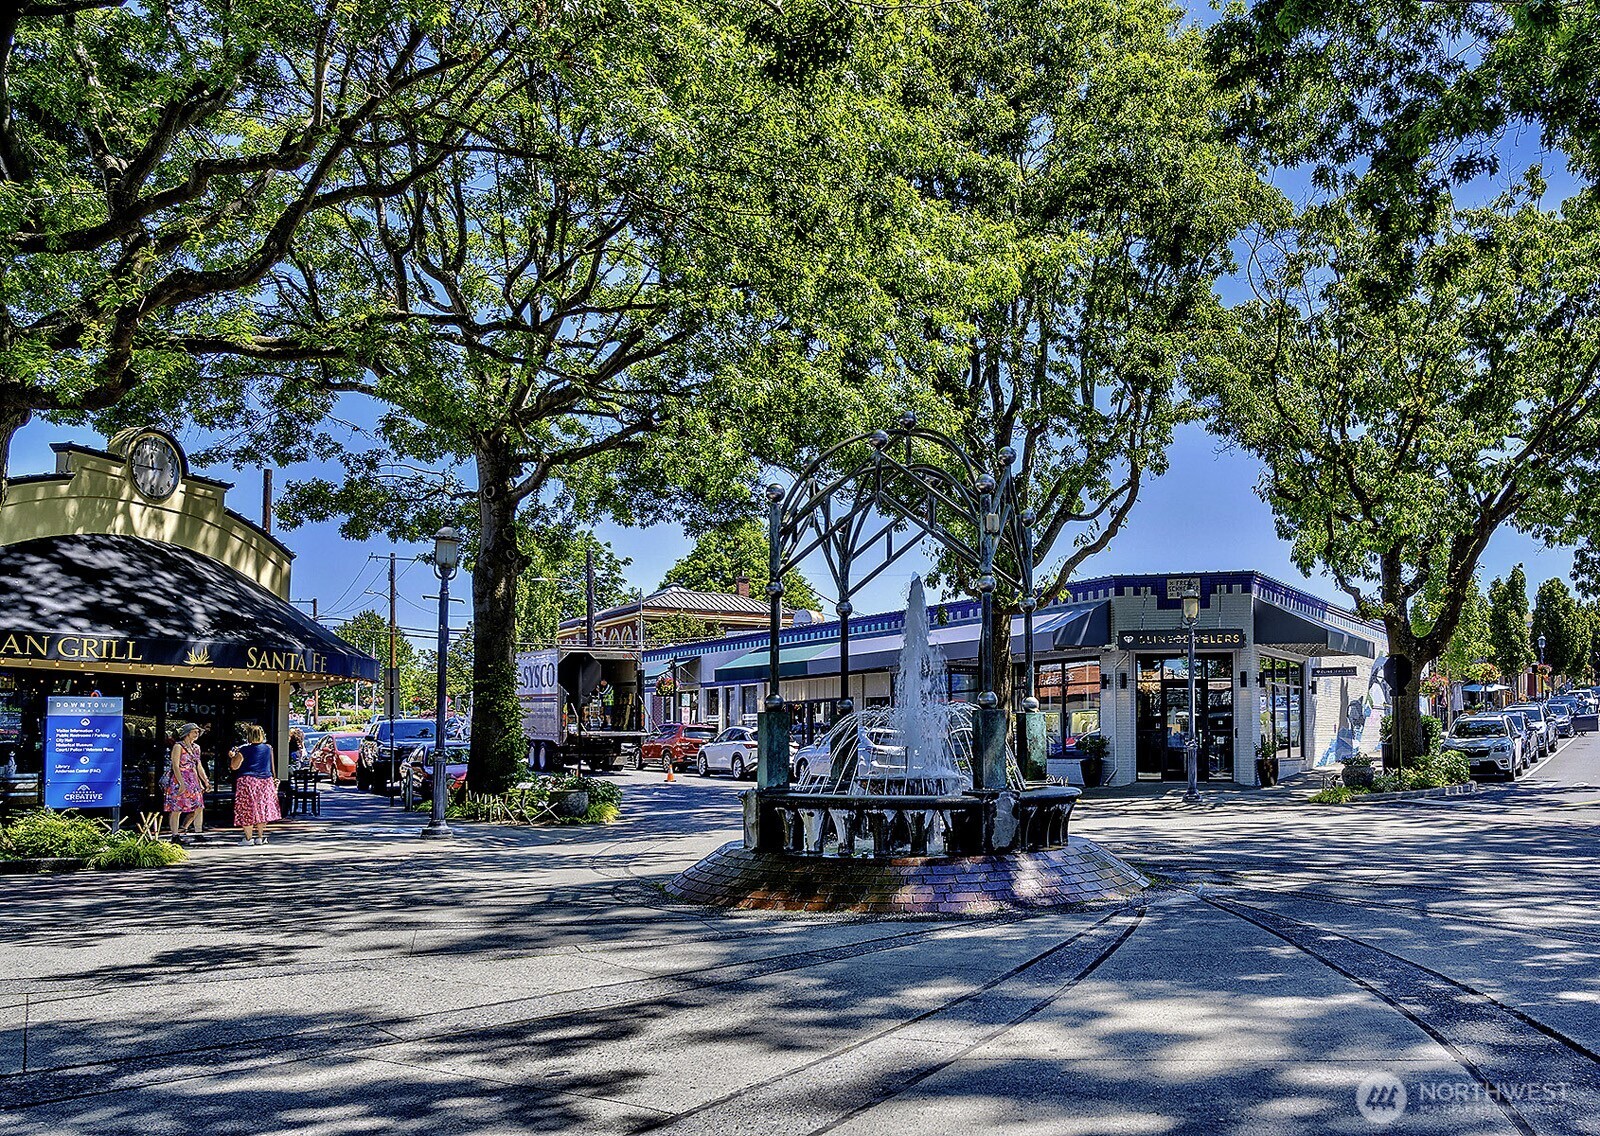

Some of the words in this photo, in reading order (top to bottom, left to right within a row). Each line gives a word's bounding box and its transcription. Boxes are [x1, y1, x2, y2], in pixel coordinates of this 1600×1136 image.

[57, 637, 143, 661] GRILL
[246, 646, 307, 672] SANTA
[312, 652, 328, 673] FE
[523, 662, 556, 688] SYSCO
[63, 793, 103, 801] CREATIVE
